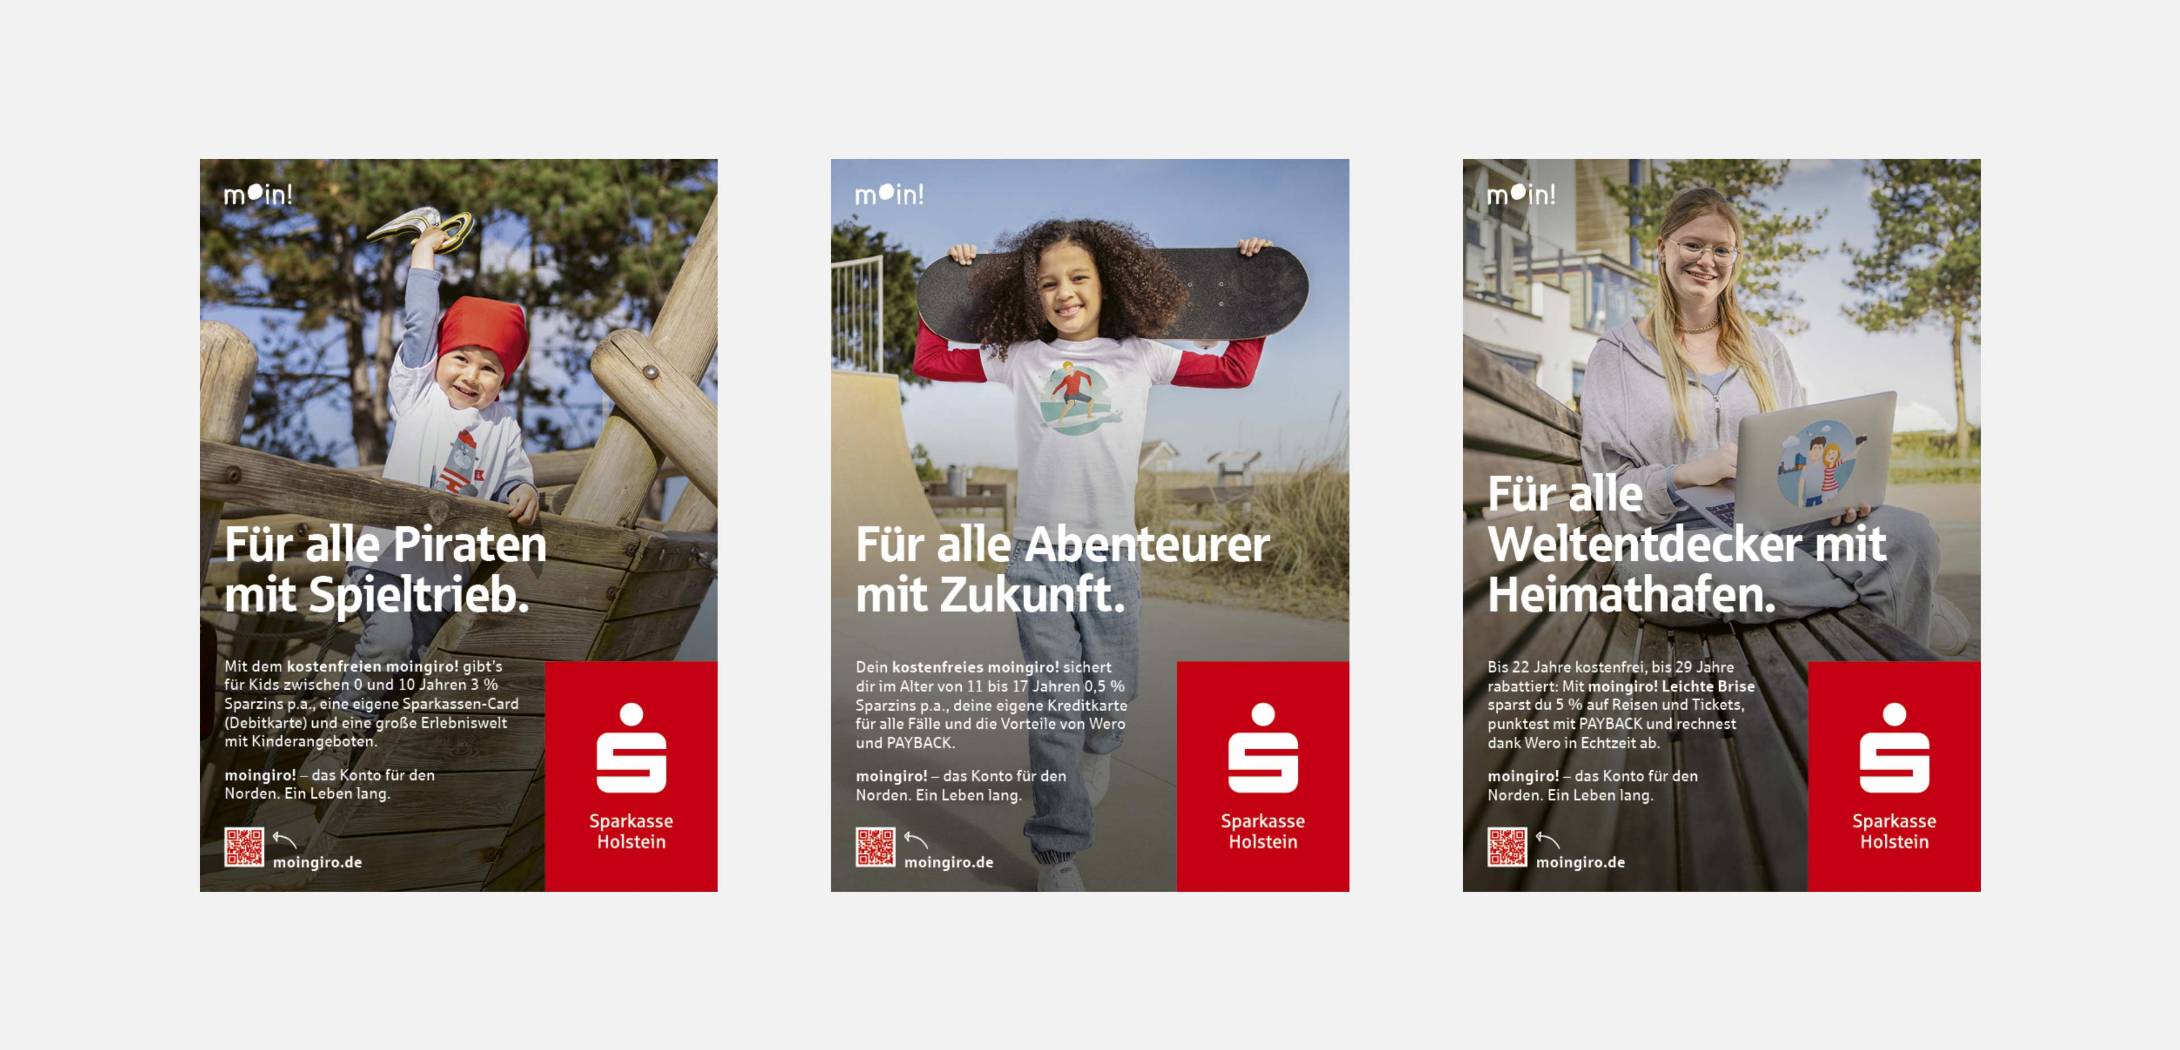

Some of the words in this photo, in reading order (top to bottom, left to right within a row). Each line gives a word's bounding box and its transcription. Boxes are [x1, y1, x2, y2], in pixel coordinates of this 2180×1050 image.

[1490, 475, 1557, 512] Für
[1569, 472, 1643, 512] alle
[227, 526, 293, 562] Für
[306, 523, 380, 563] alle
[395, 523, 546, 563] Piraten
[858, 526, 925, 562] Für
[938, 523, 1011, 562] alle
[1025, 523, 1271, 563] Abenteurer
[1488, 523, 1803, 563] Weltentdecker
[1816, 523, 1887, 562] mit
[226, 574, 297, 612] mit
[310, 573, 528, 622] Spieltrieb.
[857, 574, 929, 612] mit
[940, 573, 1124, 613] Zukunft.
[1490, 572, 1775, 613] Heimathafen.
[225, 659, 248, 672] Mit
[252, 660, 282, 673] dem
[287, 659, 382, 673] kostenfreien
[386, 659, 459, 676] moingiro!
[856, 660, 888, 674] Dein
[892, 660, 984, 674] kostenfreies
[988, 660, 1060, 677] moingiro!
[1063, 660, 1112, 674] sichert
[1488, 660, 1509, 673] Bis
[1512, 660, 1530, 674] 22
[1533, 660, 1572, 673] Jahre
[1575, 660, 1648, 675] kostenfrei,
[1652, 660, 1672, 674] bis
[1675, 660, 1692, 673] 29
[1696, 660, 1735, 673] Jahre
[224, 678, 245, 691] für
[249, 678, 280, 691] Kids
[283, 678, 350, 691] zwischen
[354, 678, 363, 691] 0
[367, 678, 394, 691] und
[399, 678, 415, 691] 10
[419, 678, 467, 691] Jahren
[471, 678, 479, 691] 3
[483, 678, 498, 691] %
[856, 679, 876, 693] dir
[878, 679, 896, 693] im
[899, 679, 935, 693] Alter
[937, 682, 963, 693] von
[967, 679, 983, 693] 11
[988, 679, 1009, 693] bis
[1013, 679, 1029, 693] 17
[1032, 679, 1080, 693] Jahren
[1084, 679, 1106, 694] 0,5
[1110, 679, 1126, 692] %
[1488, 679, 1559, 693] rabattiert:
[1562, 679, 1585, 693] Mit
[1588, 679, 1658, 696] moingiro!
[1662, 679, 1714, 693] Leichte
[1718, 679, 1756, 693] Brise
[224, 697, 284, 713] Sparzins
[287, 700, 316, 713] p.a.,
[319, 697, 349, 710] eine
[352, 697, 399, 713] eigene
[403, 697, 519, 713] Sparkassen-Card
[855, 698, 917, 715] Sparzins
[920, 702, 950, 715] p.a.,
[953, 698, 993, 712] deine
[996, 698, 1044, 715] eigene
[1048, 698, 1128, 712] Kreditkarte
[1488, 699, 1531, 714] sparst
[1534, 698, 1552, 711] du
[1556, 697, 1564, 711] 5
[1568, 698, 1583, 711] %
[1587, 697, 1610, 711] auf
[1612, 697, 1658, 711] Reisen
[1662, 698, 1688, 711] und
[1691, 698, 1745, 713] Tickets,
[225, 716, 307, 730] (Debitkarte)
[311, 716, 338, 729] und
[342, 716, 372, 729] eine
[375, 716, 417, 733] große
[421, 716, 508, 729] Erlebniswelt
[855, 717, 877, 730] für
[879, 717, 904, 730] alle
[908, 717, 941, 730] Fälle
[945, 717, 972, 730] und
[975, 717, 998, 730] die
[1000, 717, 1056, 730] Vorteile
[1059, 720, 1085, 730] von
[1089, 717, 1126, 730] Wero
[1488, 717, 1550, 733] punktest
[1553, 718, 1576, 730] mit
[1579, 717, 1643, 730] PAYBACK
[1646, 717, 1673, 730] und
[1676, 717, 1737, 730] rechnest
[225, 735, 248, 747] mit
[252, 734, 377, 751] Kinderangeboten.
[856, 736, 883, 749] und
[887, 736, 956, 749] PAYBACK.
[1488, 736, 1522, 749] dank
[1524, 736, 1561, 749] Wero
[1564, 736, 1577, 749] in
[1581, 736, 1637, 749] Echtzeit
[1639, 736, 1660, 749] ab.
[225, 768, 296, 785] moingiro!
[311, 768, 336, 781] das
[340, 768, 382, 781] Konto
[385, 768, 405, 781] für
[409, 768, 435, 781] den
[856, 769, 928, 786] moingiro!
[943, 769, 968, 782] das
[971, 769, 1013, 782] Konto
[1016, 769, 1037, 782] für
[1040, 769, 1067, 782] den
[1488, 769, 1559, 786] moingiro!
[1575, 769, 1599, 782] das
[1603, 769, 1645, 782] Konto
[1648, 769, 1669, 782] für
[1672, 769, 1698, 782] den
[225, 787, 280, 800] Norden.
[285, 786, 306, 800] Ein
[310, 787, 353, 800] Leben
[356, 786, 391, 803] lang.
[856, 788, 912, 801] Norden.
[916, 788, 938, 801] Ein
[942, 788, 984, 801] Leben
[988, 788, 1022, 805] lang.
[1488, 788, 1543, 801] Norden.
[1548, 788, 1569, 801] Ein
[1573, 788, 1616, 801] Leben
[1620, 788, 1654, 805] lang.
[589, 812, 674, 832] Sparkasse
[1221, 813, 1306, 832] Sparkasse
[1853, 813, 1937, 832] Sparkasse
[598, 833, 666, 849] Holstein
[1229, 833, 1298, 849] Holstein
[1861, 833, 1929, 849] Holstein
[273, 855, 362, 872] moingiro.de
[904, 855, 994, 872] moingiro.de
[1536, 855, 1626, 872] moingiro.de
